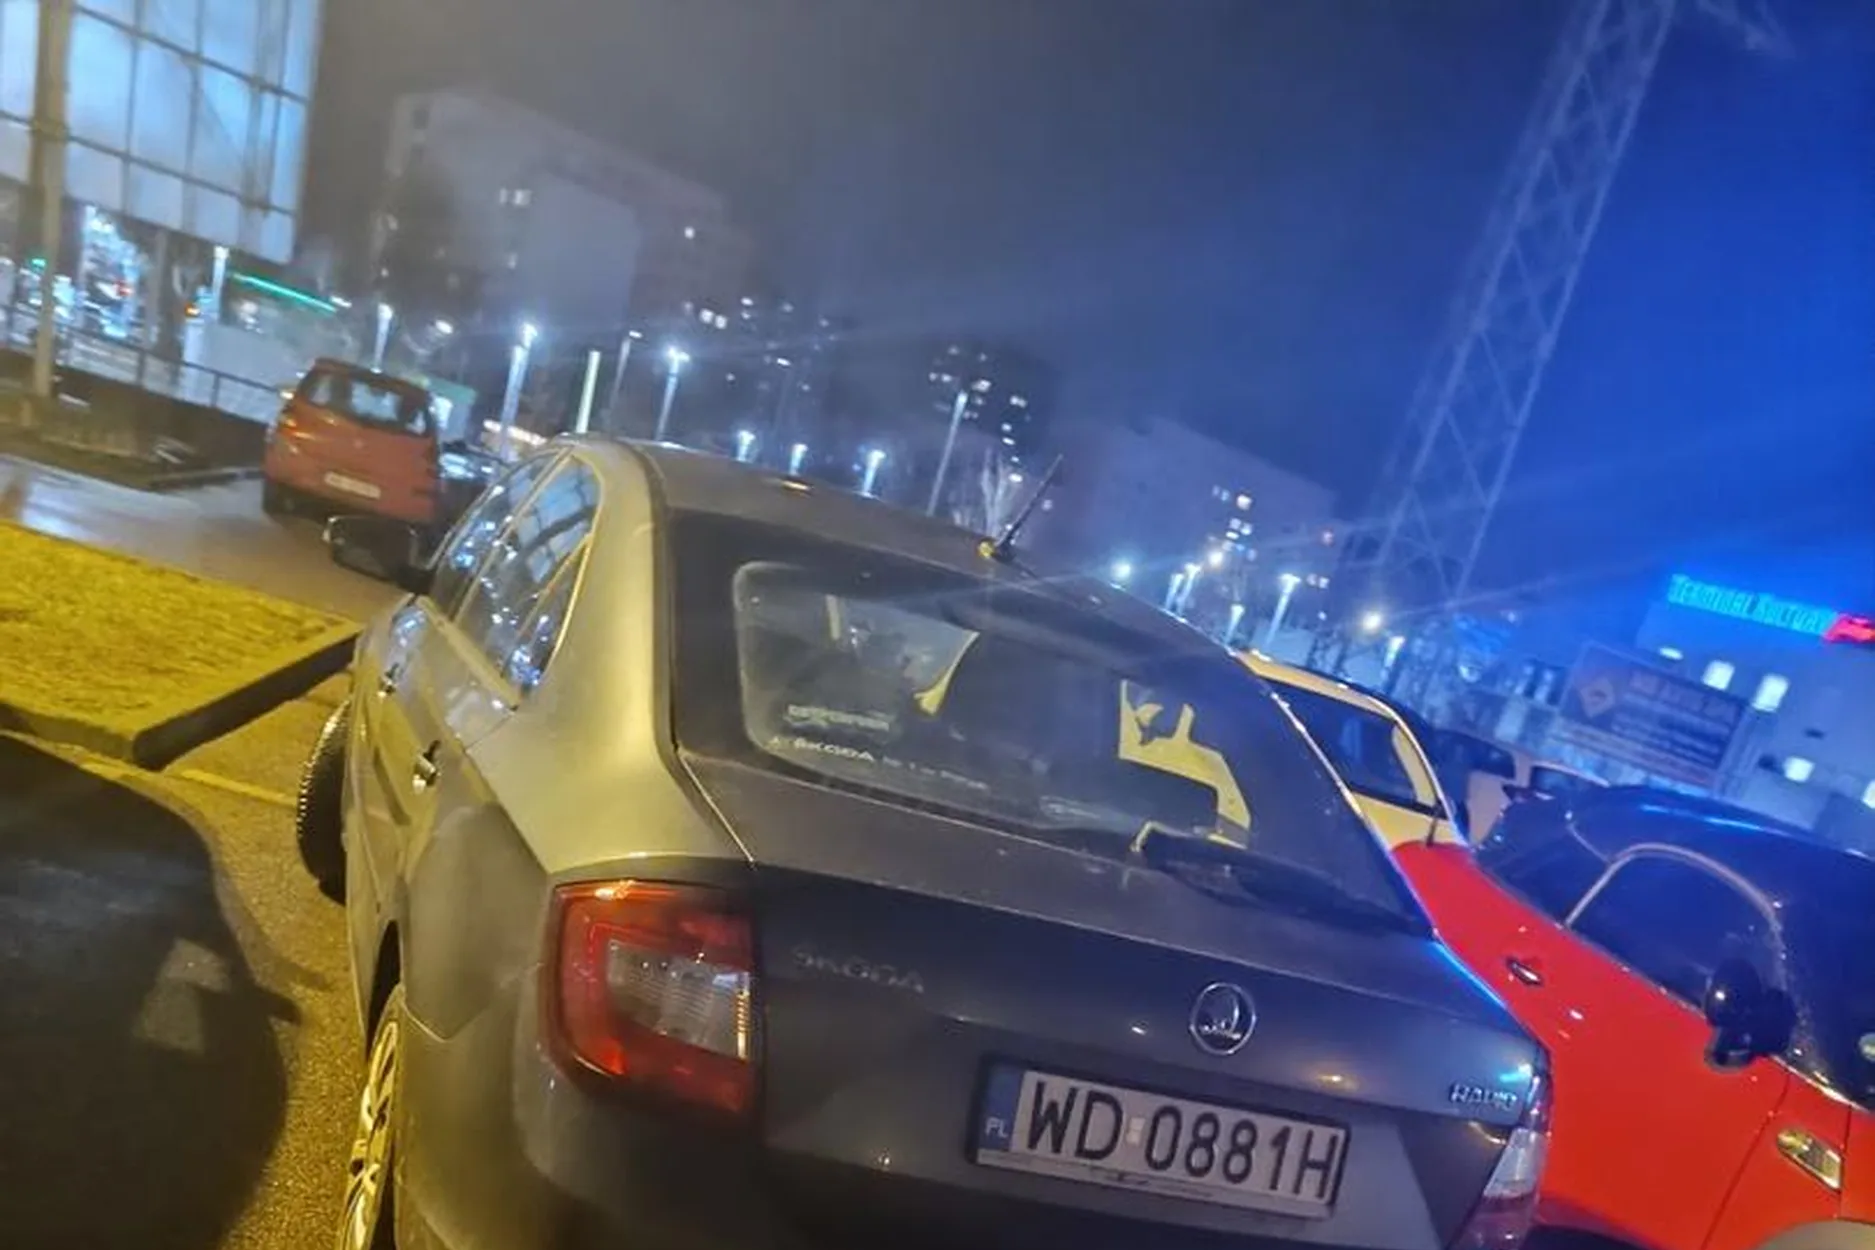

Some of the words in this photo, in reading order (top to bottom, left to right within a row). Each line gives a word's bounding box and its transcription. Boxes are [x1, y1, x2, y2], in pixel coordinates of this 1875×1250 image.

[984, 1120, 1009, 1139] PL
[1026, 1081, 1124, 1160] WD
[1144, 1105, 1341, 1199] 0881H
